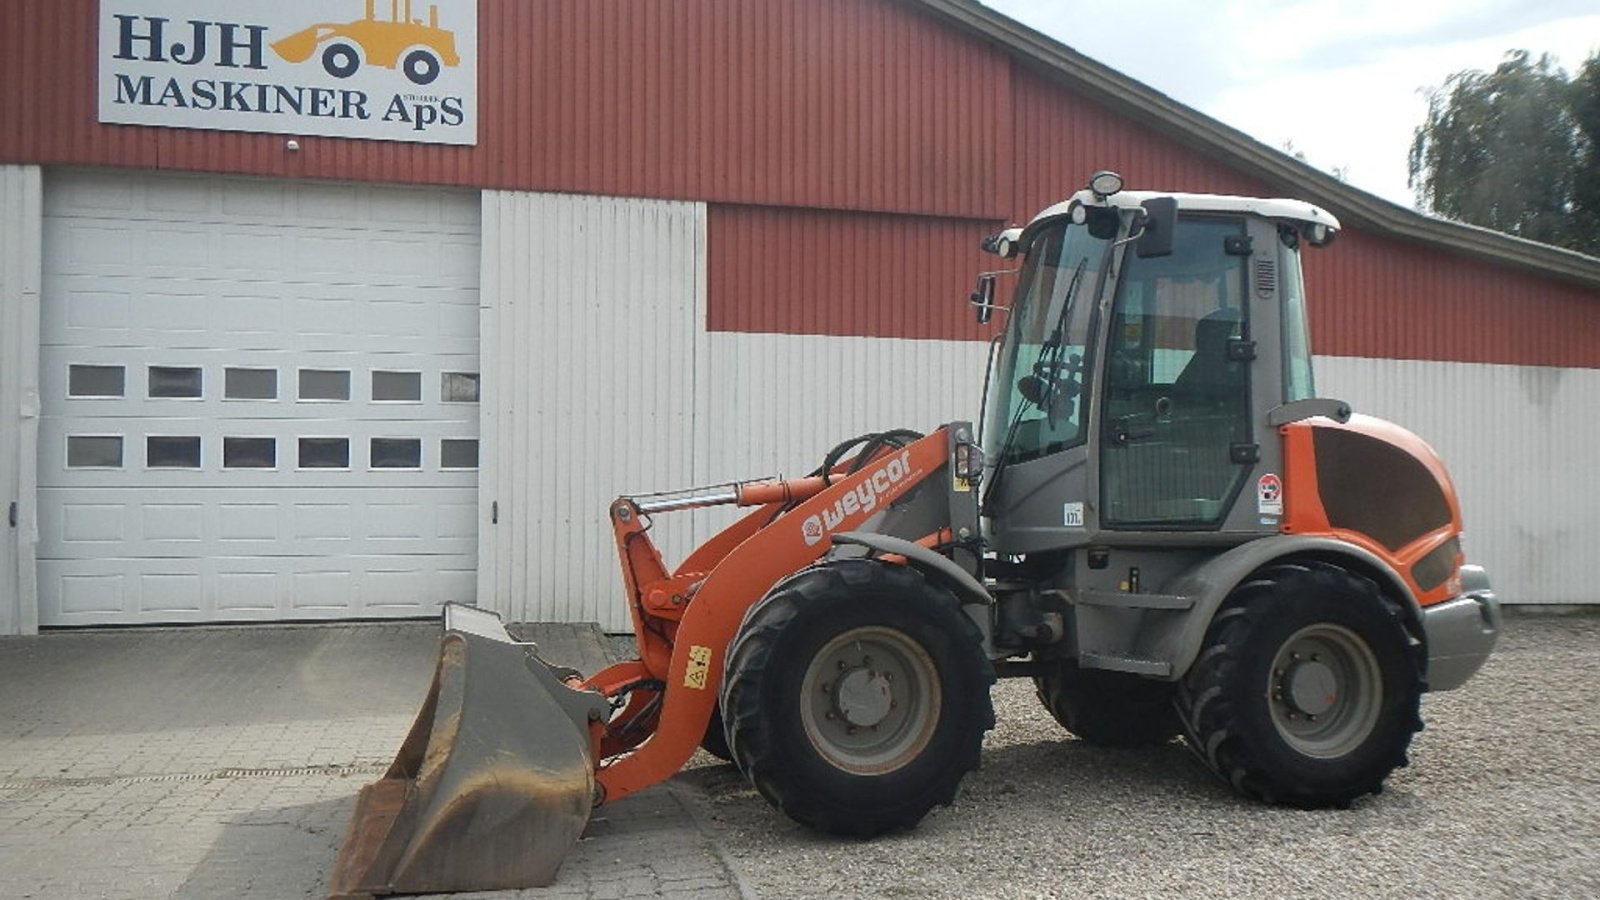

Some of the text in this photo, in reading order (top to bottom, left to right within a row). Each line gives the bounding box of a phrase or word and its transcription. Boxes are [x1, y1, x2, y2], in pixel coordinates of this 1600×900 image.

[113, 14, 268, 69] HJH
[113, 74, 464, 130] MASKINER ApS
[822, 450, 910, 531] weycor
